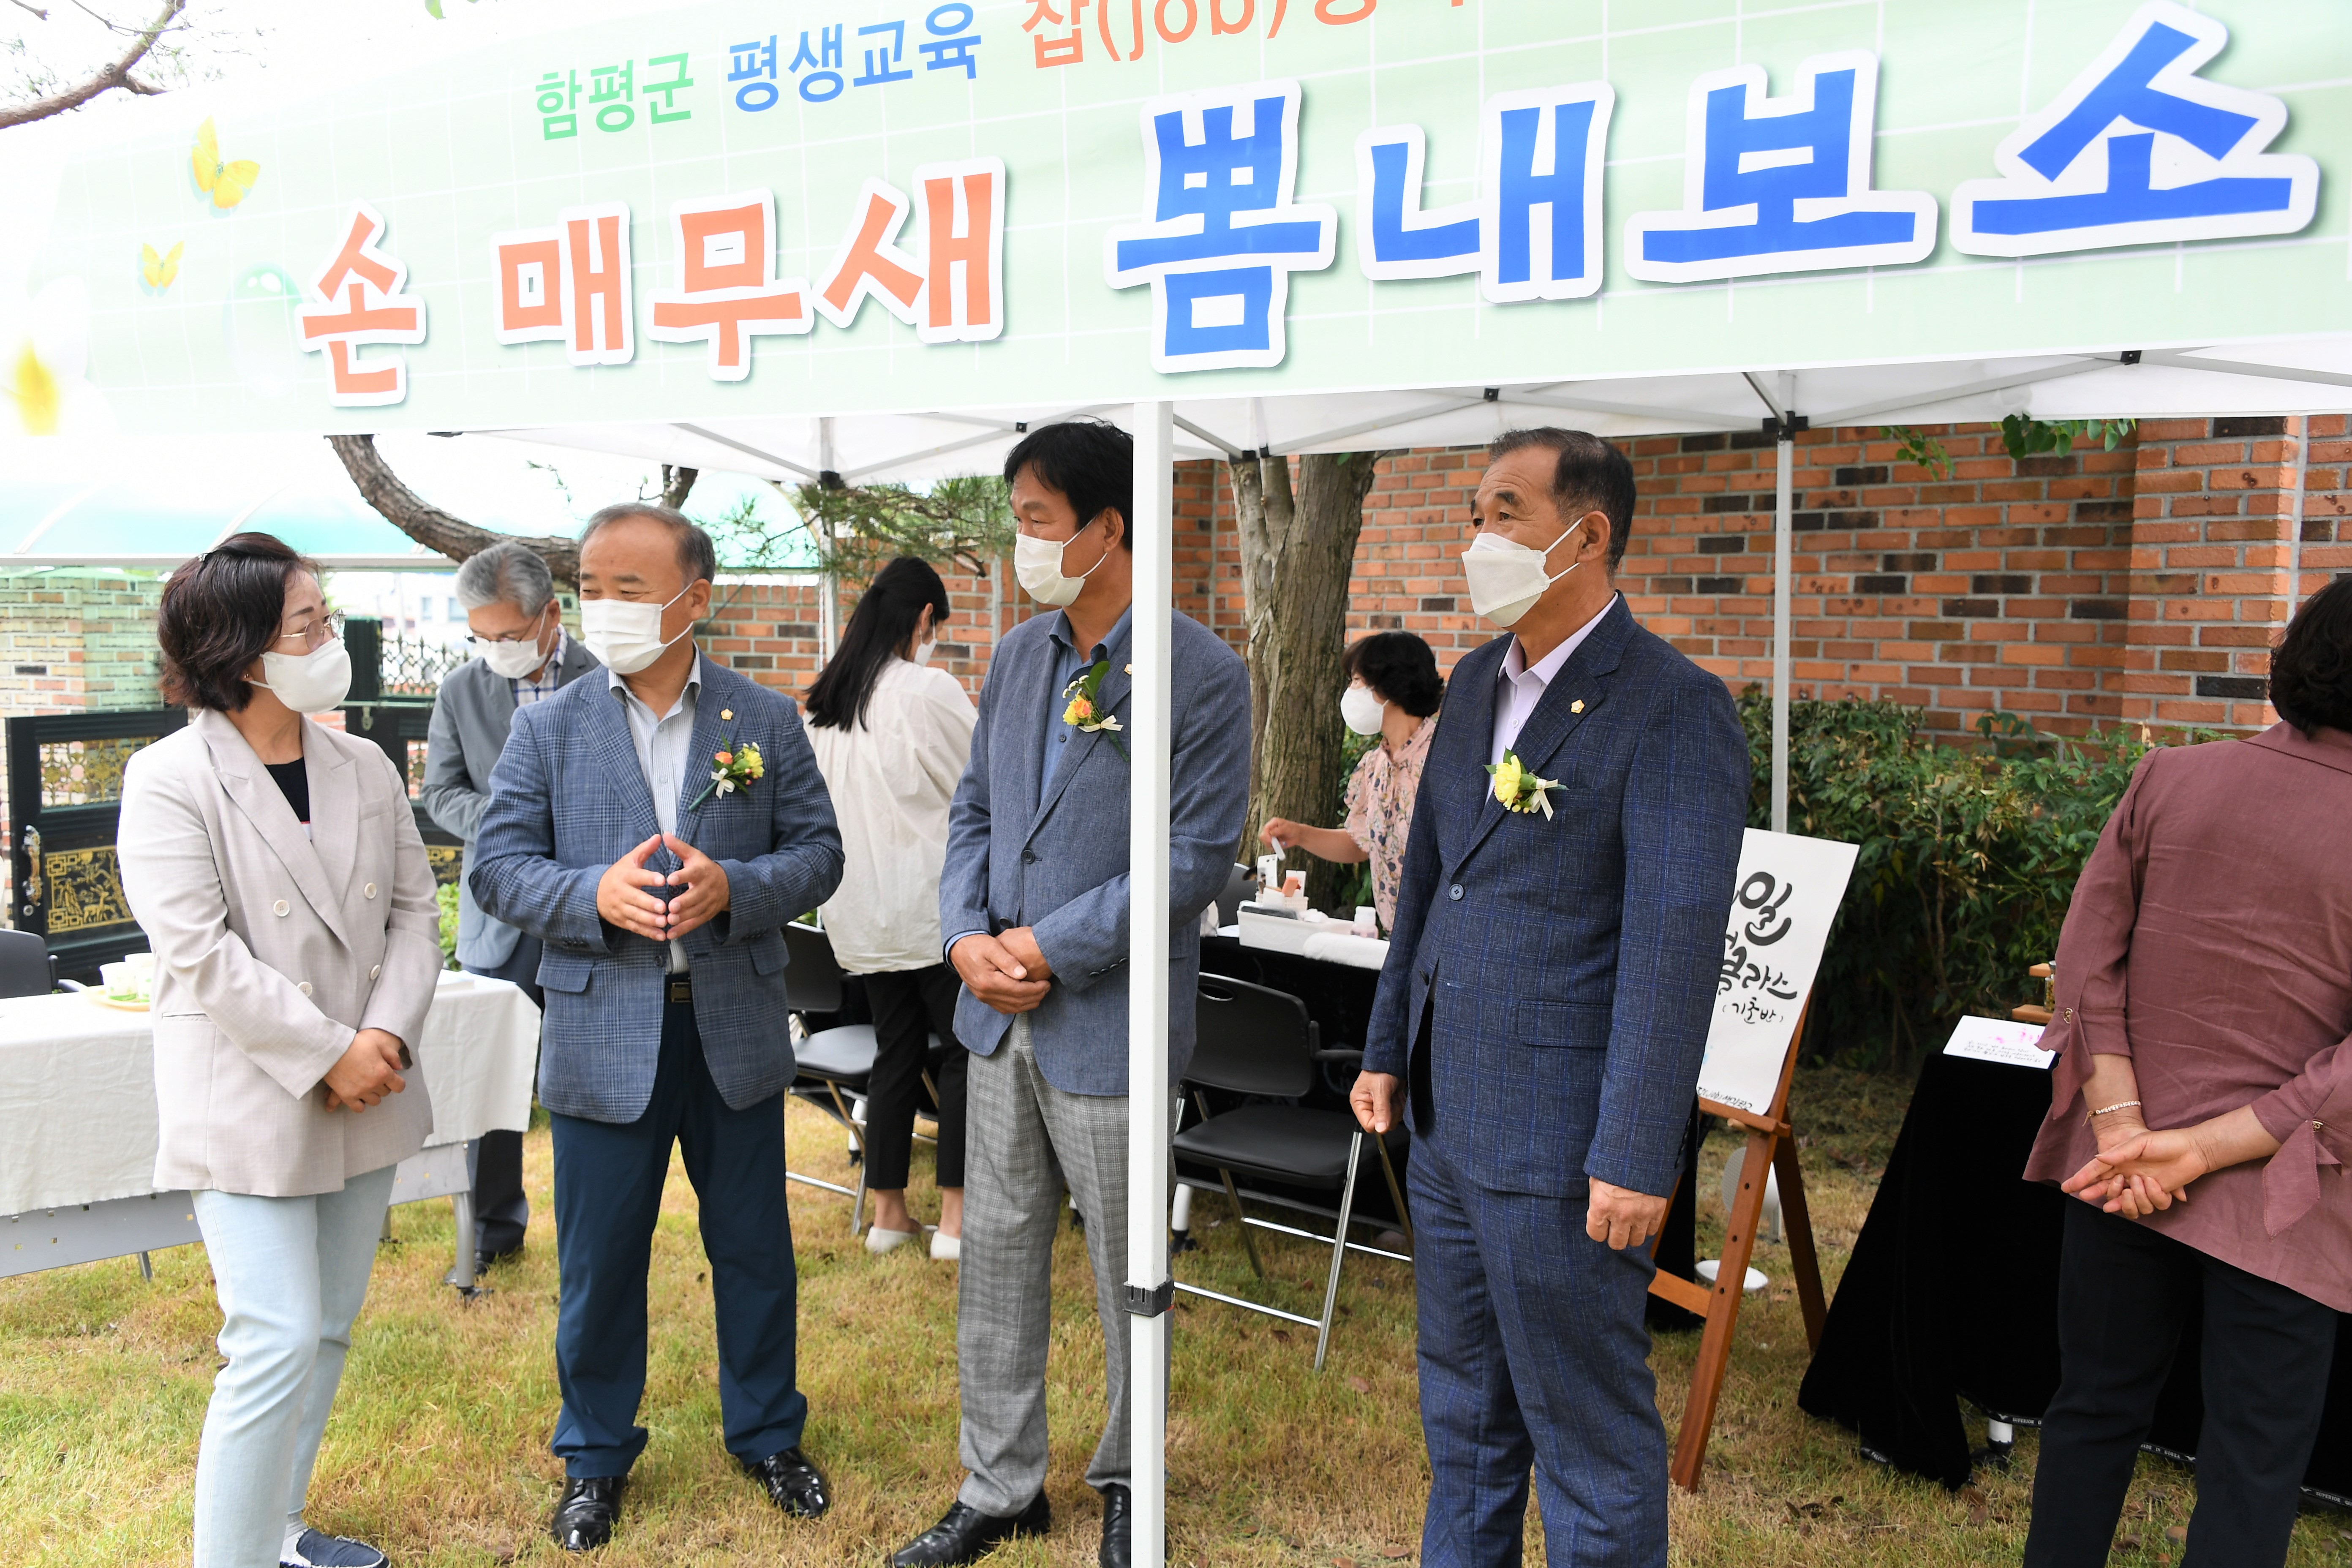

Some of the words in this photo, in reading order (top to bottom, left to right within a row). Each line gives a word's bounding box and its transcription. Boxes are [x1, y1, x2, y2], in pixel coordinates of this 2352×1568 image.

[536, 52, 694, 141] 함평군
[727, 3, 982, 112] 평생교육
[302, 212, 417, 393] 손
[498, 172, 992, 366] 매무새
[1116, 21, 2292, 357] 뽐내보소
[1731, 871, 1792, 946] 일
[1722, 996, 1783, 1024] (기초반)
[2316, 1492, 2341, 1503] SUPERIOR
